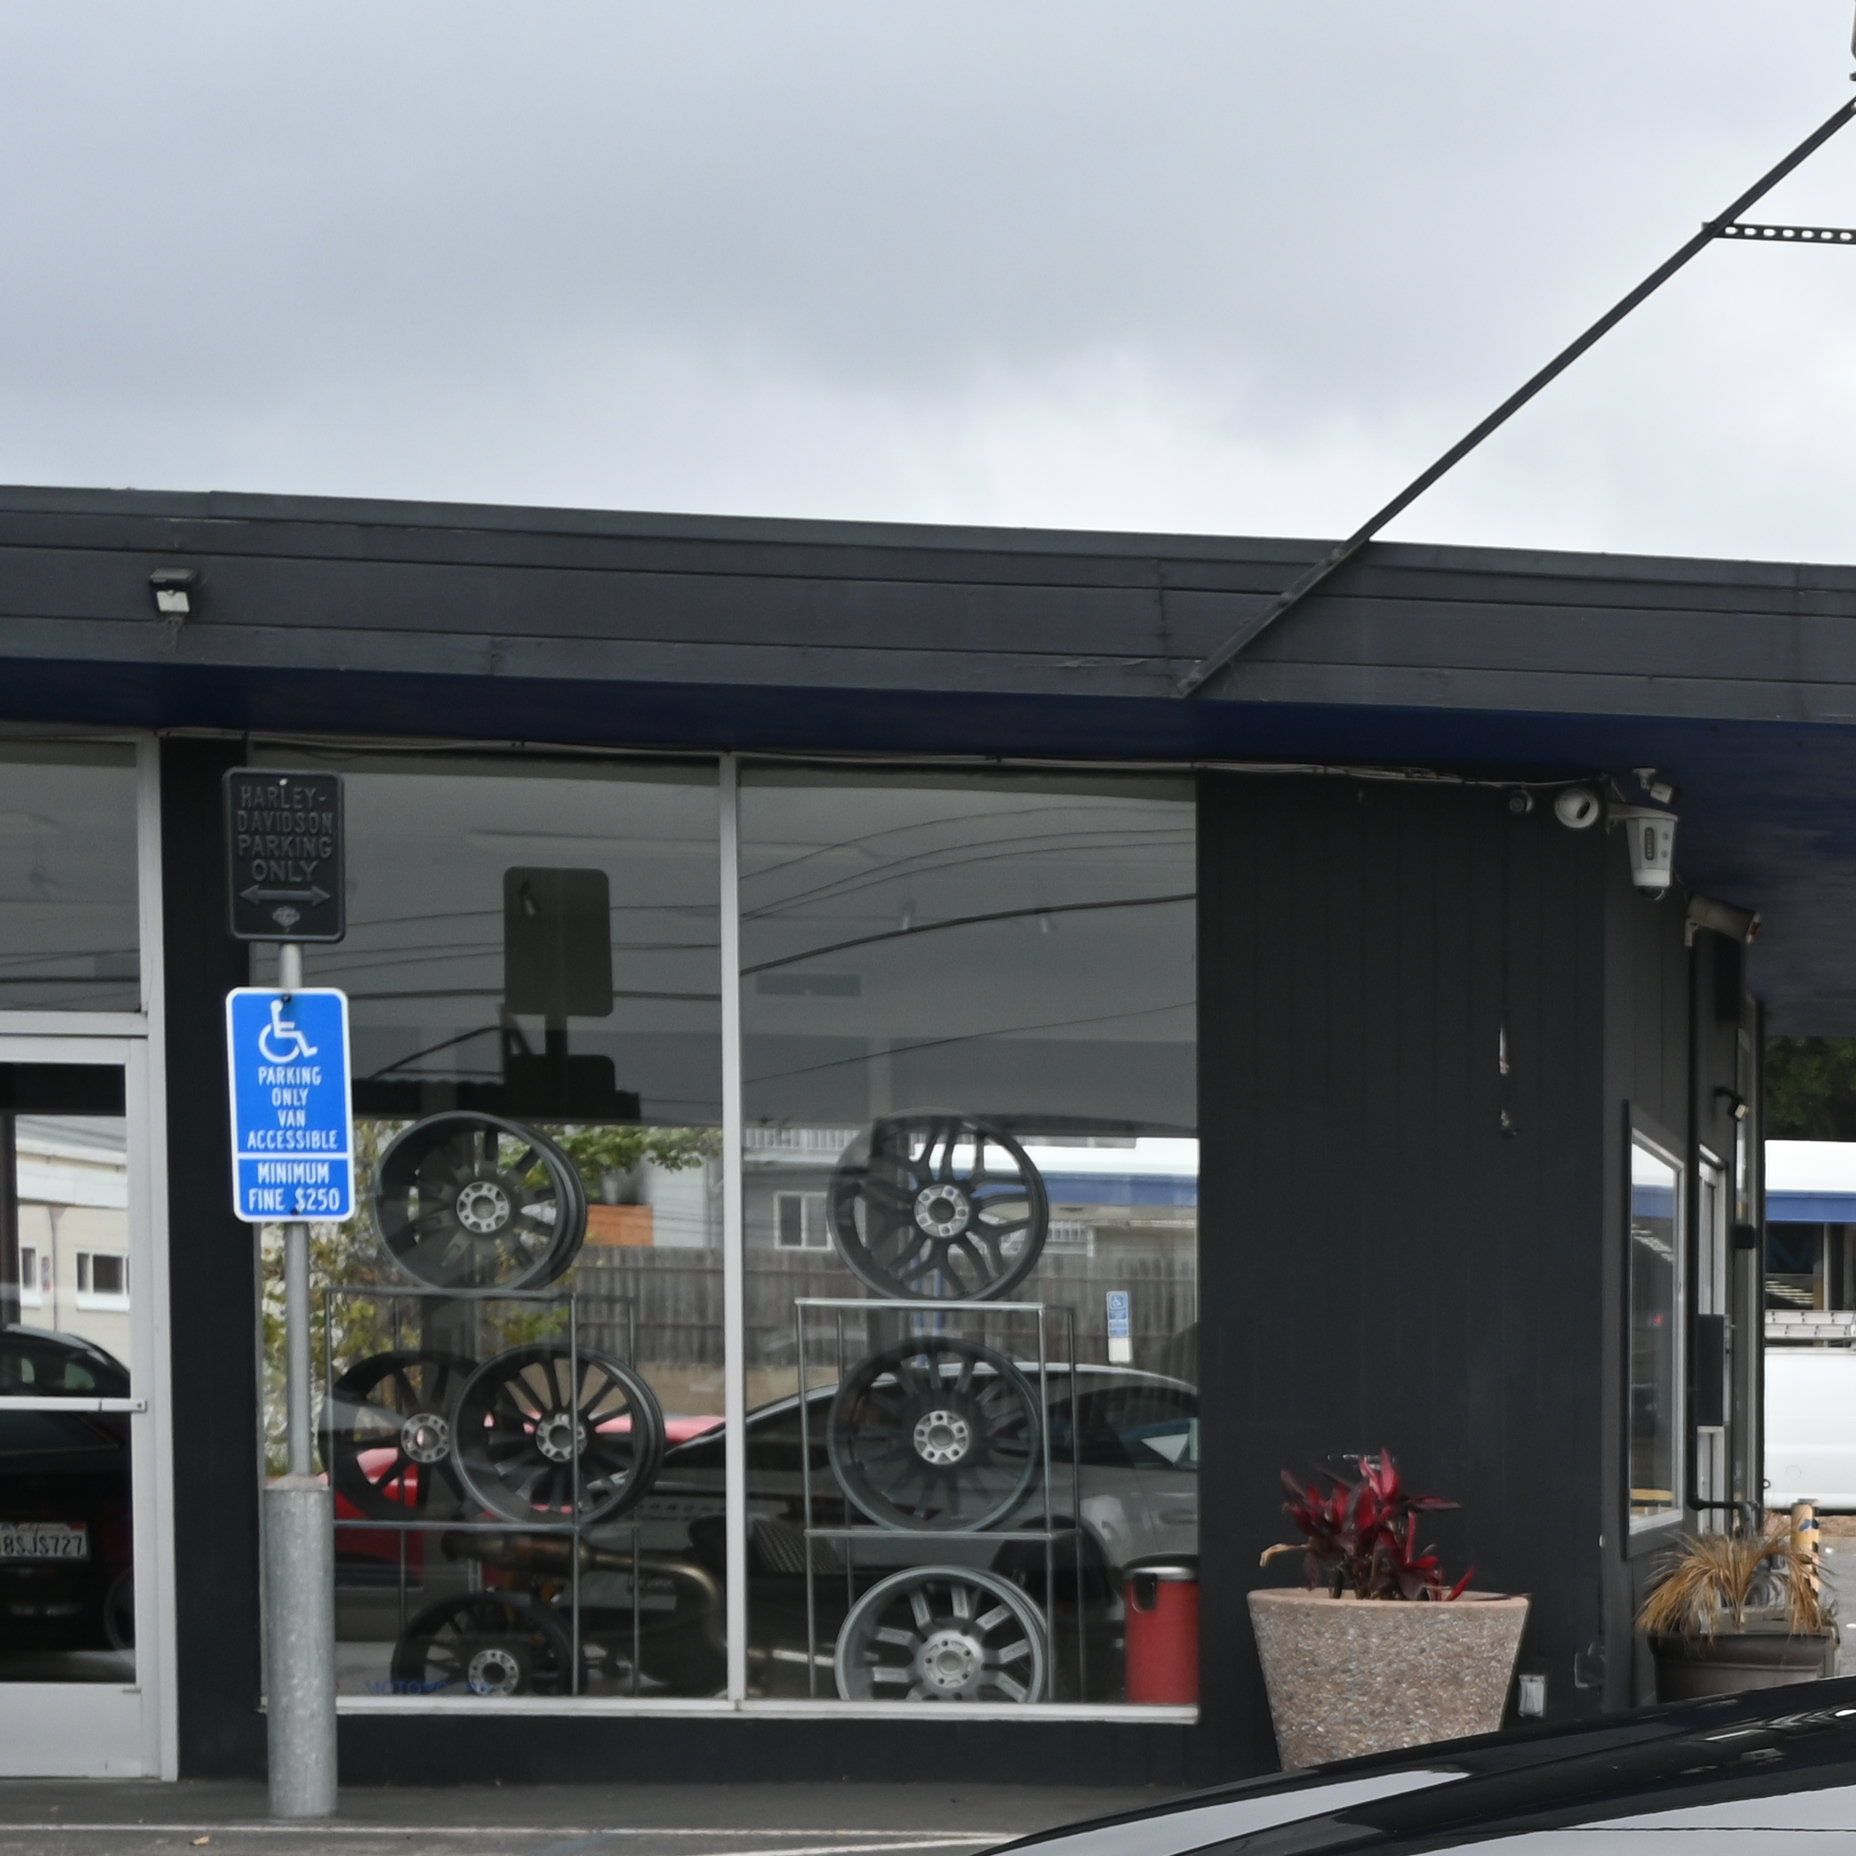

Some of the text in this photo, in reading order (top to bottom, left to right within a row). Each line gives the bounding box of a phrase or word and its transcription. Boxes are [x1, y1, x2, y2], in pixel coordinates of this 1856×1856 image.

[241, 785, 327, 809] HARLEY-
[237, 810, 334, 834] DAVIDSON
[237, 834, 332, 859] PARKING
[251, 858, 319, 882] ONLY
[257, 1065, 322, 1086] PARKING
[271, 1087, 309, 1107] ONLY
[277, 1108, 306, 1128] VAN
[246, 1129, 339, 1151] ACCESSIBLE
[257, 1161, 330, 1185] MINIMUM
[248, 1185, 340, 1212] FINE $250
